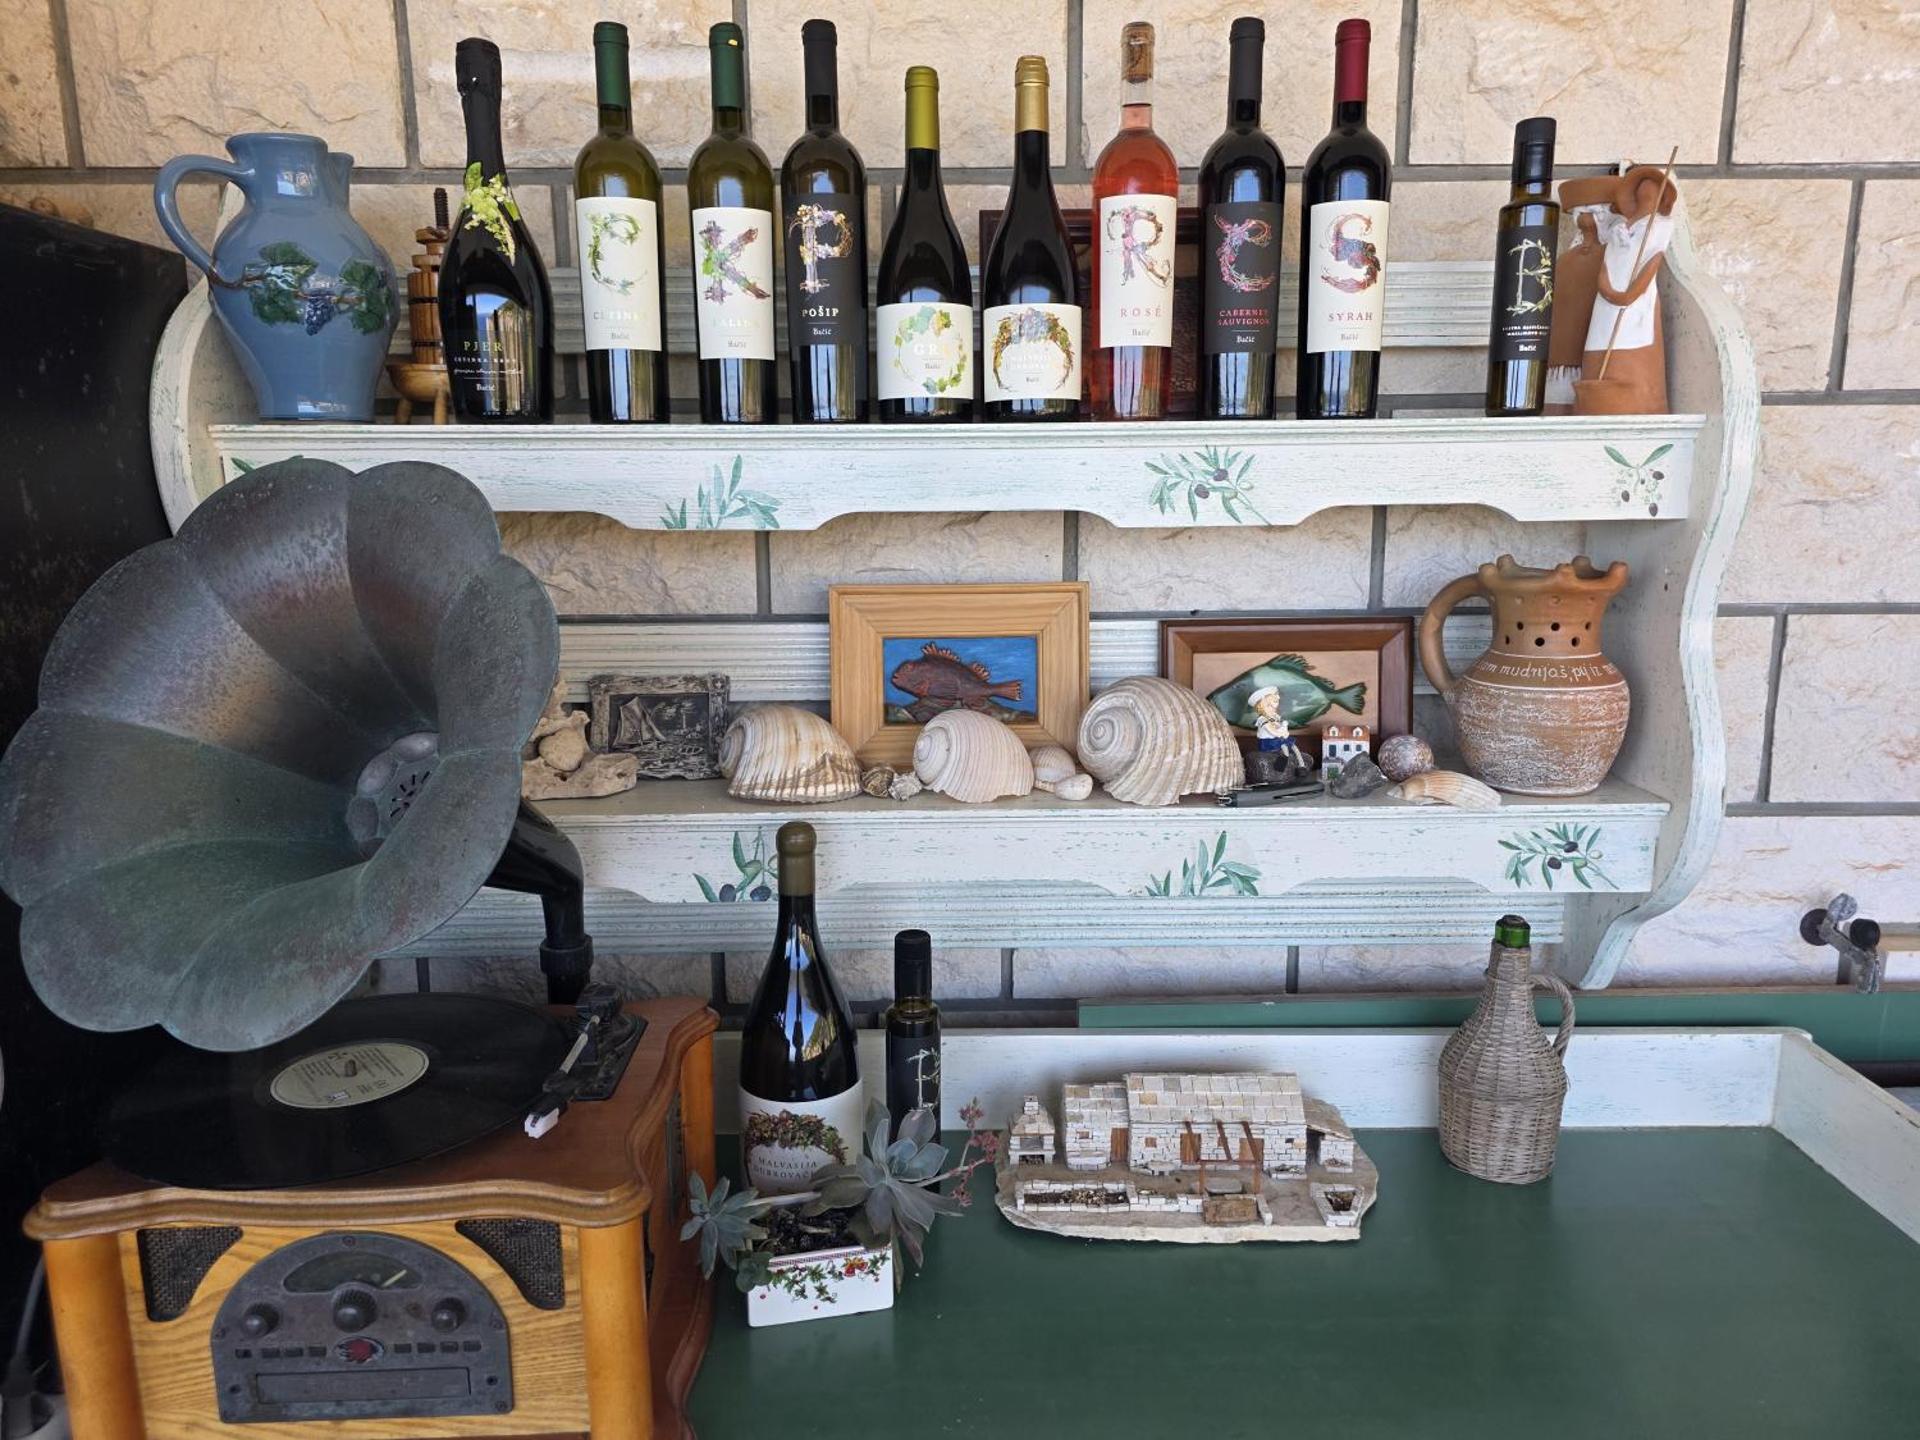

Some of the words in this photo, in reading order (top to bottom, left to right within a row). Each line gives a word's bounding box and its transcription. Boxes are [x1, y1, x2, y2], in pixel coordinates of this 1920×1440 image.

[697, 219, 771, 305] K
[802, 305, 840, 318] POŠIP
[1120, 305, 1161, 318] ROSÉ
[1219, 308, 1269, 318] CABERNET
[1328, 312, 1373, 322] SYRAH
[1217, 318, 1271, 327] SAUVIGNON
[464, 341, 504, 352] PJER
[758, 1155, 817, 1168] MALVASIJA
